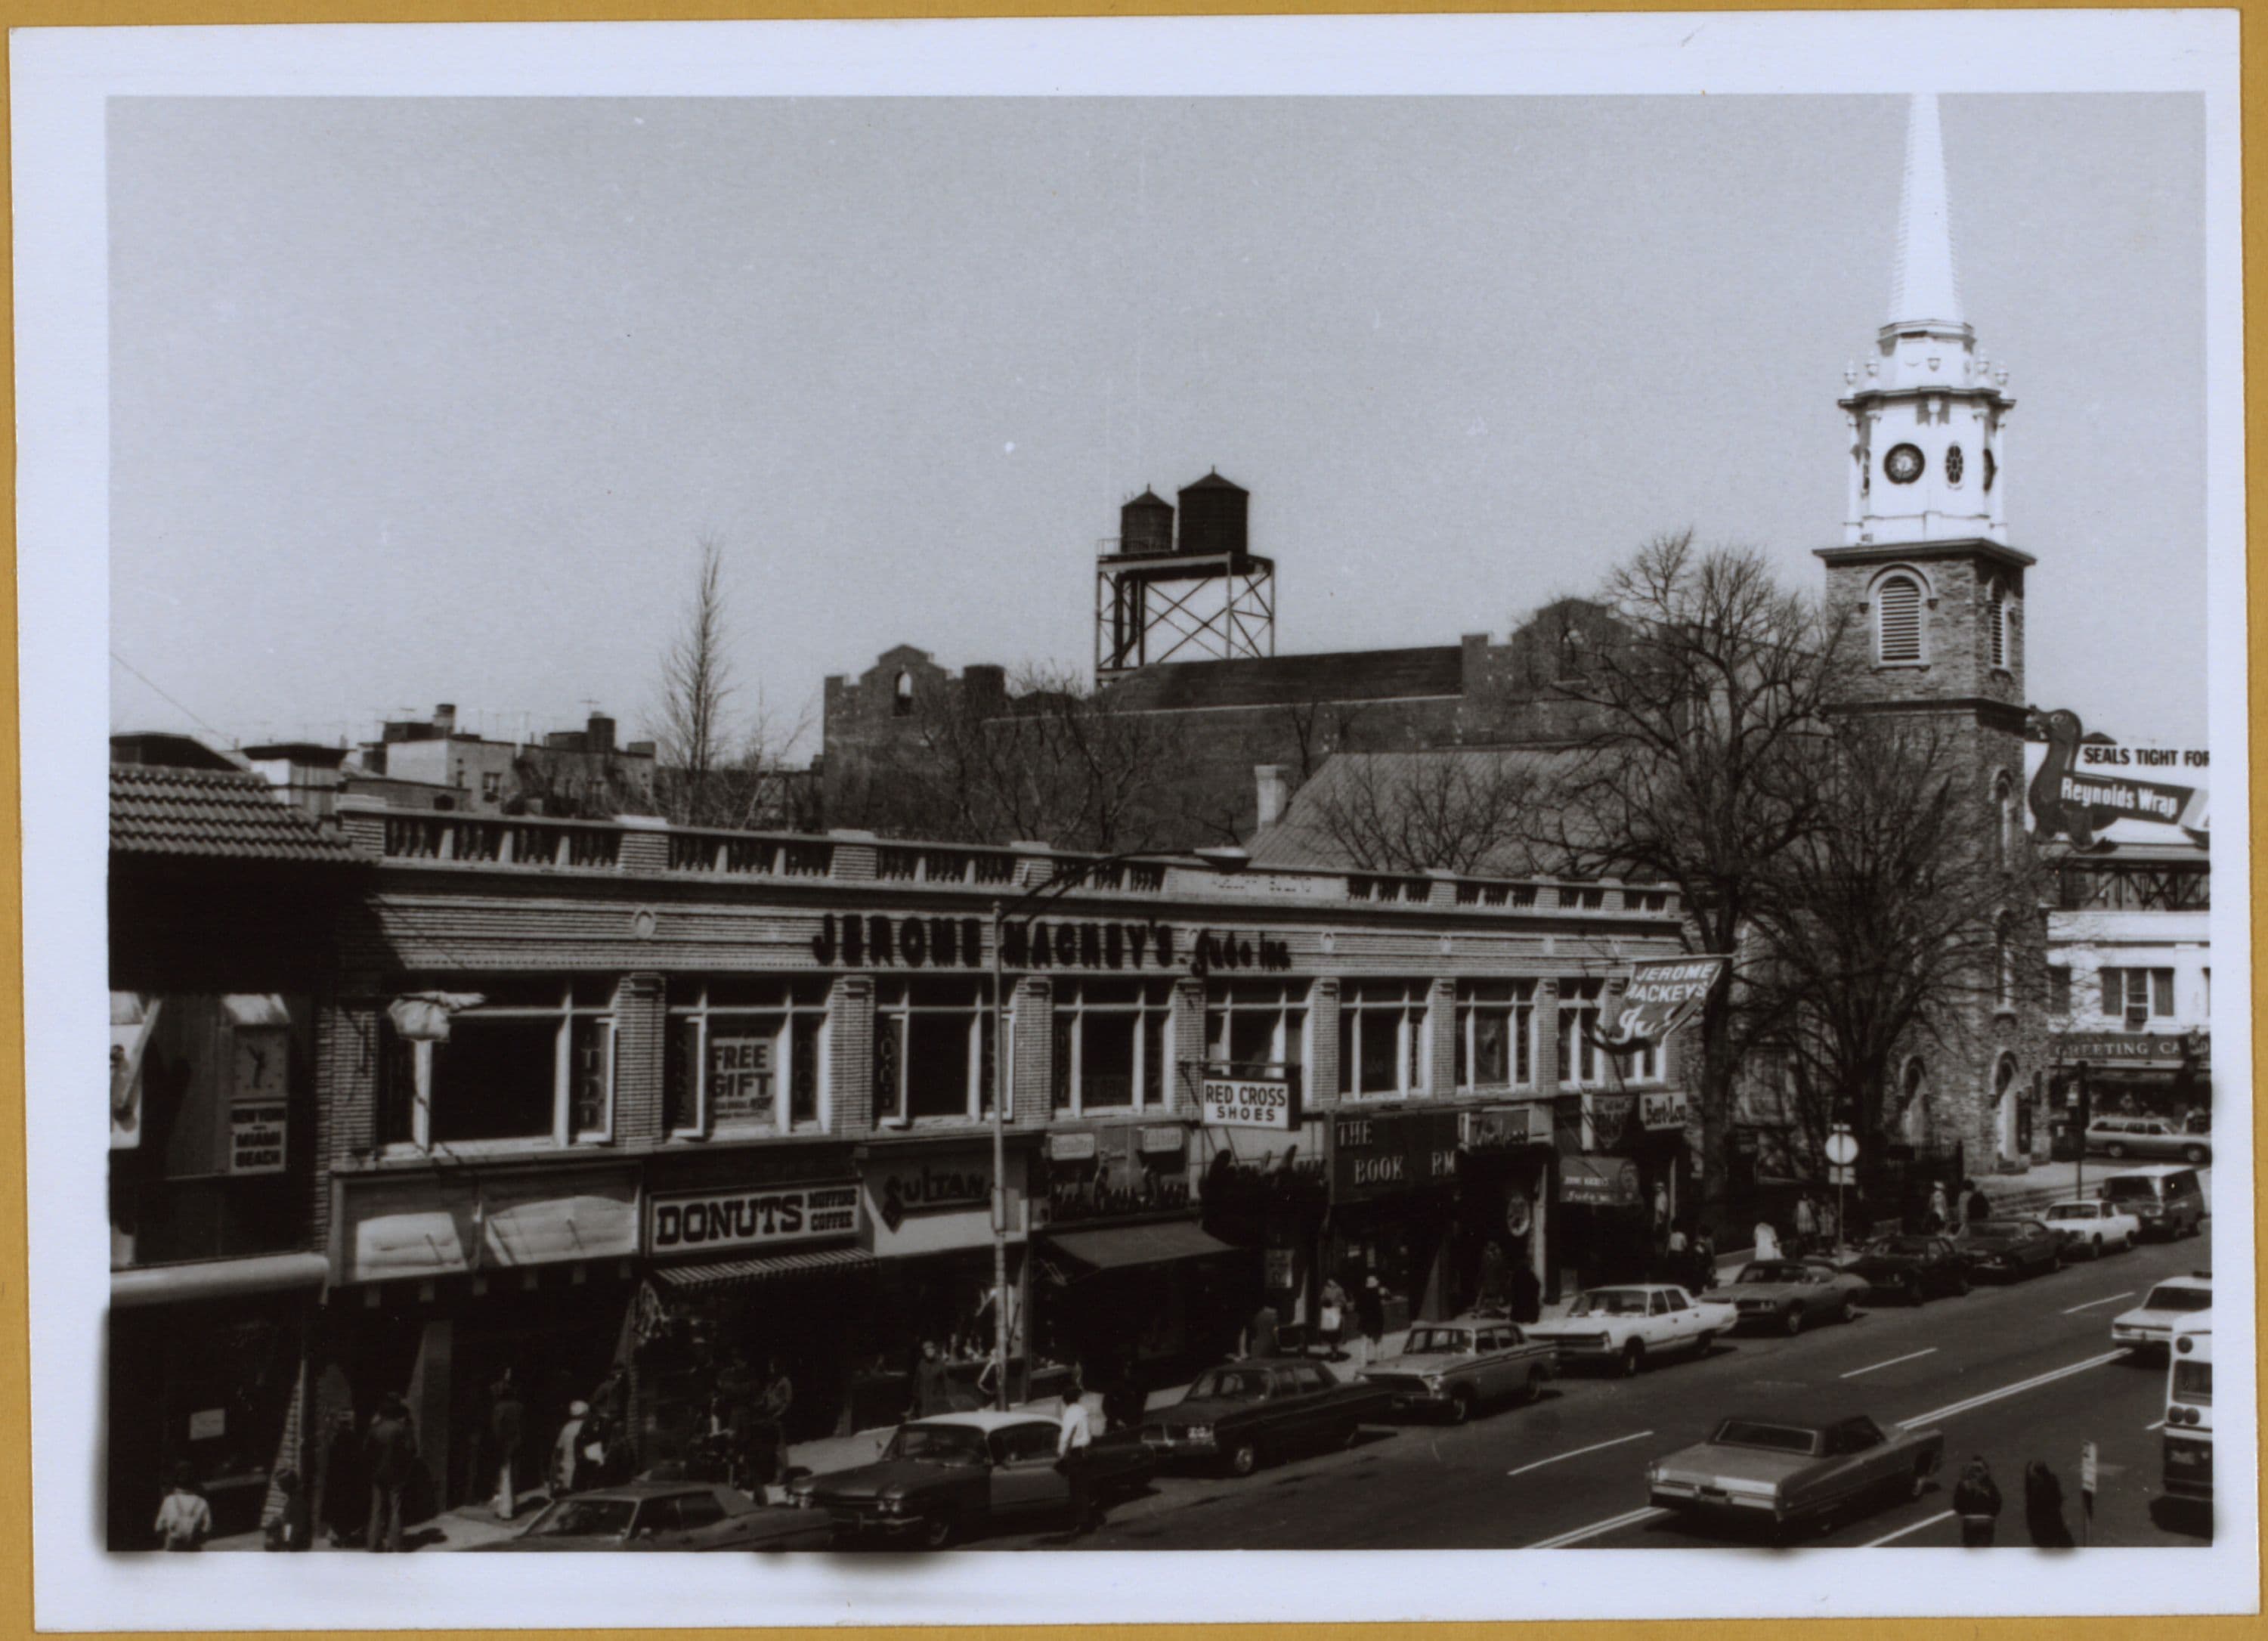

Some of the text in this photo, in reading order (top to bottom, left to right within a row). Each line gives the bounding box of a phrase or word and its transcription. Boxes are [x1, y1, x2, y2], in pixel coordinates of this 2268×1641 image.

[2084, 746, 2130, 766] SEALS
[2136, 748, 2179, 766] TIGHT
[2060, 777, 2178, 818] Reynolds Wrap
[812, 914, 981, 968] JEROME
[1635, 962, 1718, 981] JEROME
[708, 1045, 767, 1070] FREE
[707, 1073, 773, 1098] GIFT
[1205, 1085, 1286, 1107] RED CROSS
[1217, 1106, 1275, 1121] SHOES
[1336, 1121, 1373, 1147] THE
[1354, 1155, 1403, 1184] BOOK
[657, 1194, 803, 1246] DONUTS
[811, 1211, 852, 1232] COFFEE
